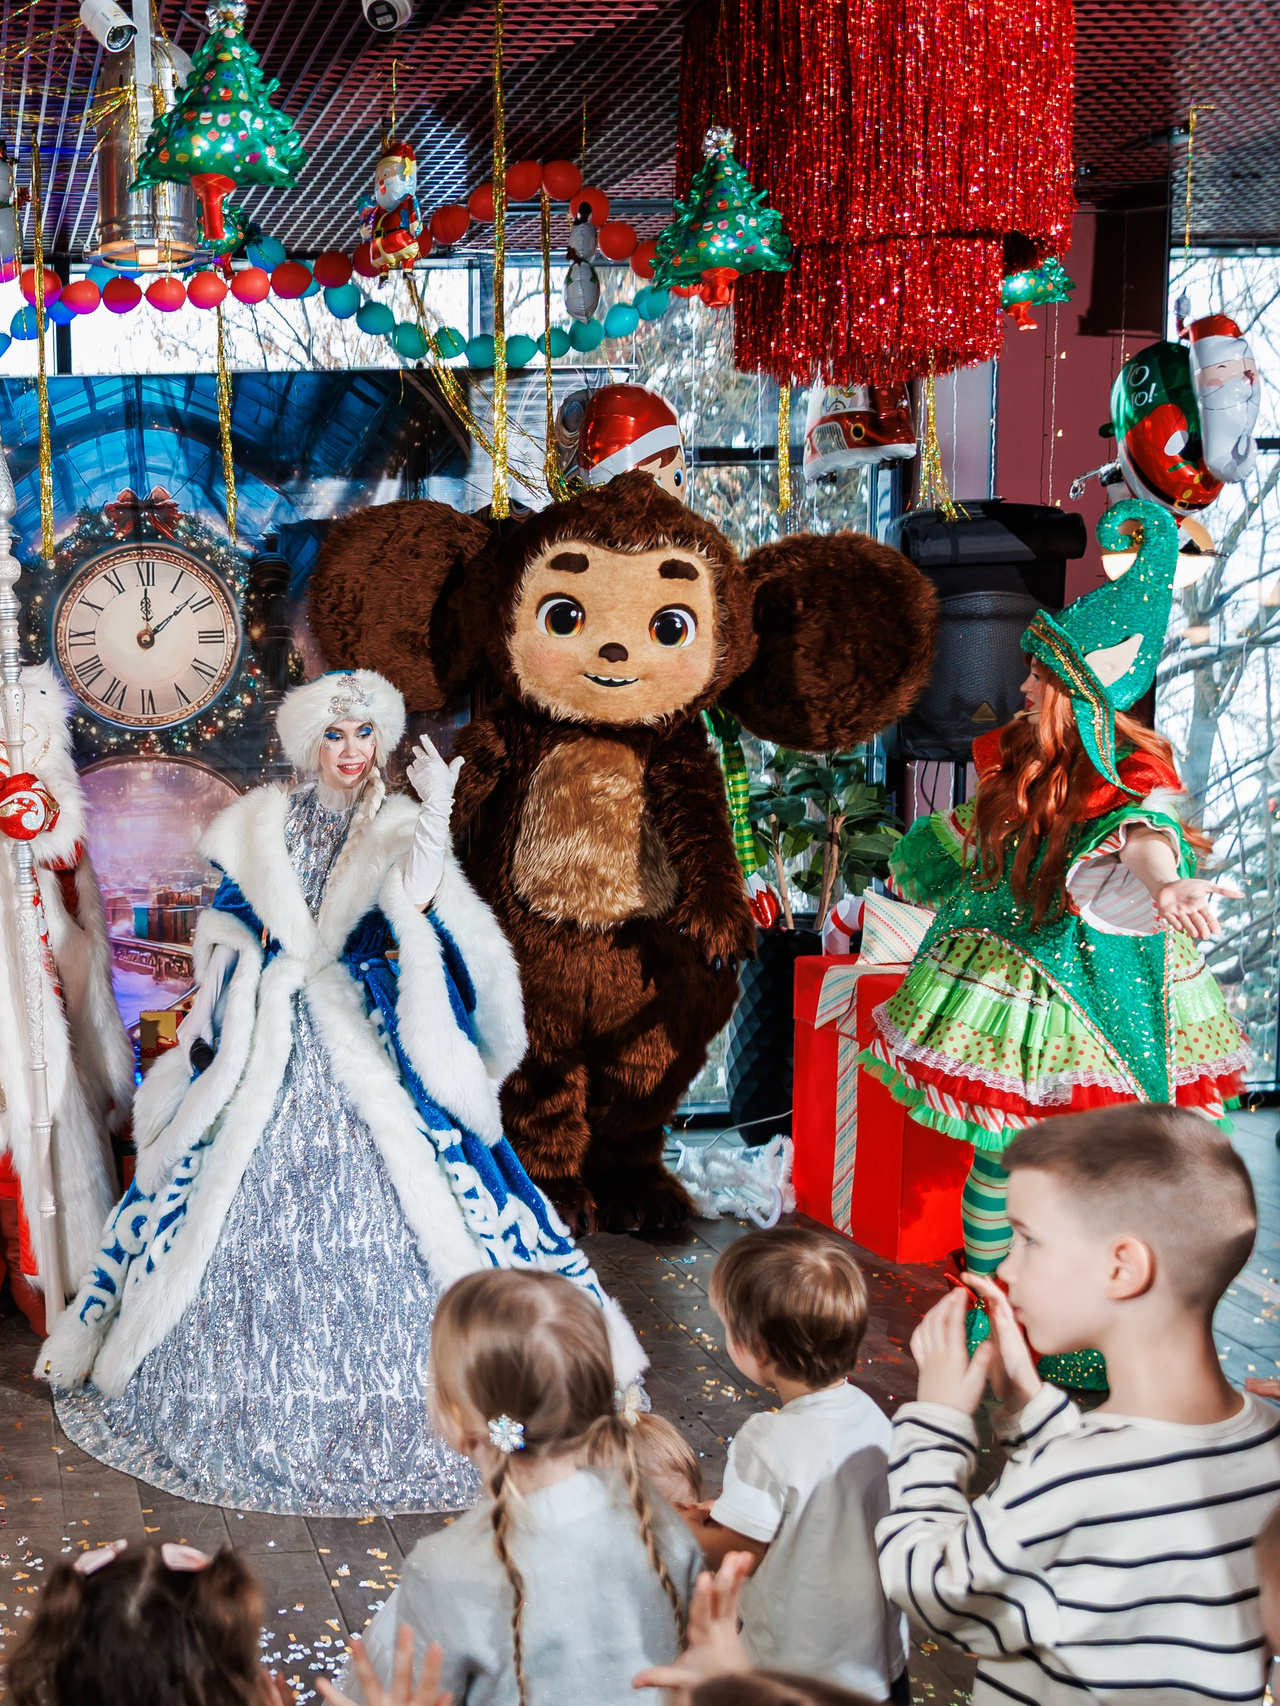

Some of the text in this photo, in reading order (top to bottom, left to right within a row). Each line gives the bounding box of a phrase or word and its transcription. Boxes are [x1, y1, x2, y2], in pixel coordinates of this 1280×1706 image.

[102, 569, 126, 598] XI
[135, 561, 156, 587] XII
[78, 595, 105, 617] X
[189, 595, 215, 614] II
[68, 628, 97, 648] IX
[198, 629, 225, 645] III
[191, 657, 219, 686] IV
[101, 676, 129, 711] VII
[140, 688, 158, 715] VI
[173, 682, 192, 707] V
